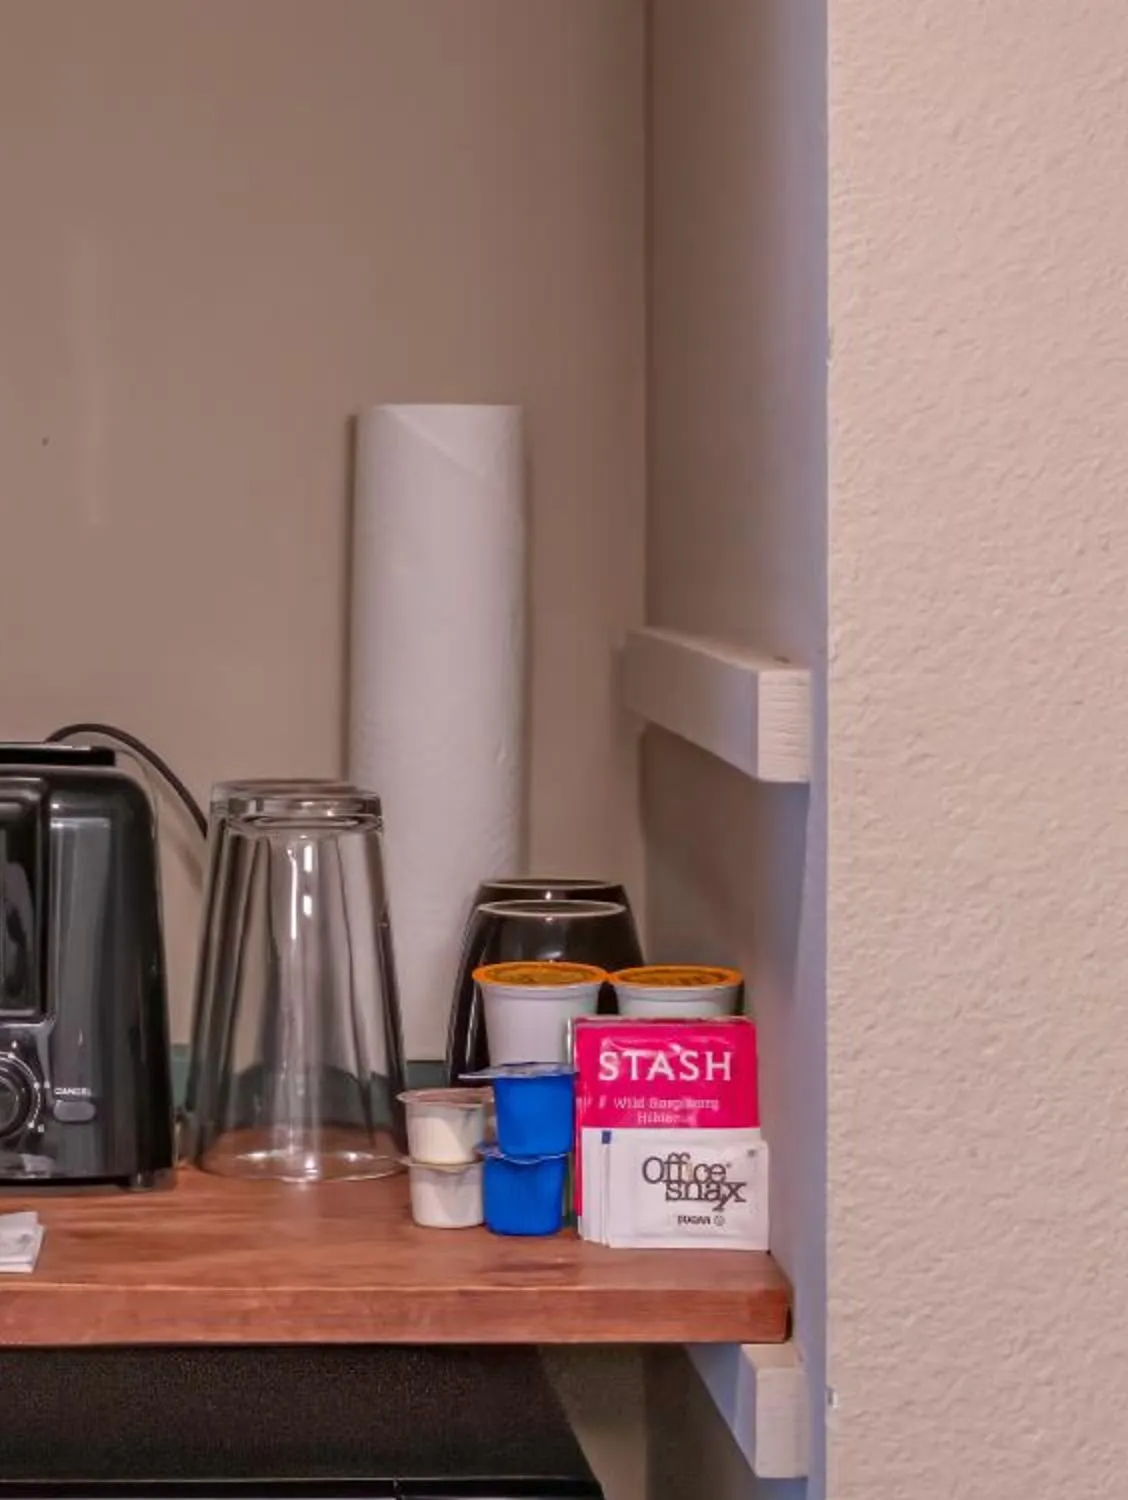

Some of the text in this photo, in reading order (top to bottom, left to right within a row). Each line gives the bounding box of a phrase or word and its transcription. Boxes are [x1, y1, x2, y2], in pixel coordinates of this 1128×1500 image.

[597, 1050, 733, 1082] STASH
[613, 1096, 645, 1109] Wild
[641, 1152, 727, 1184] Office
[664, 1180, 747, 1212] snax
